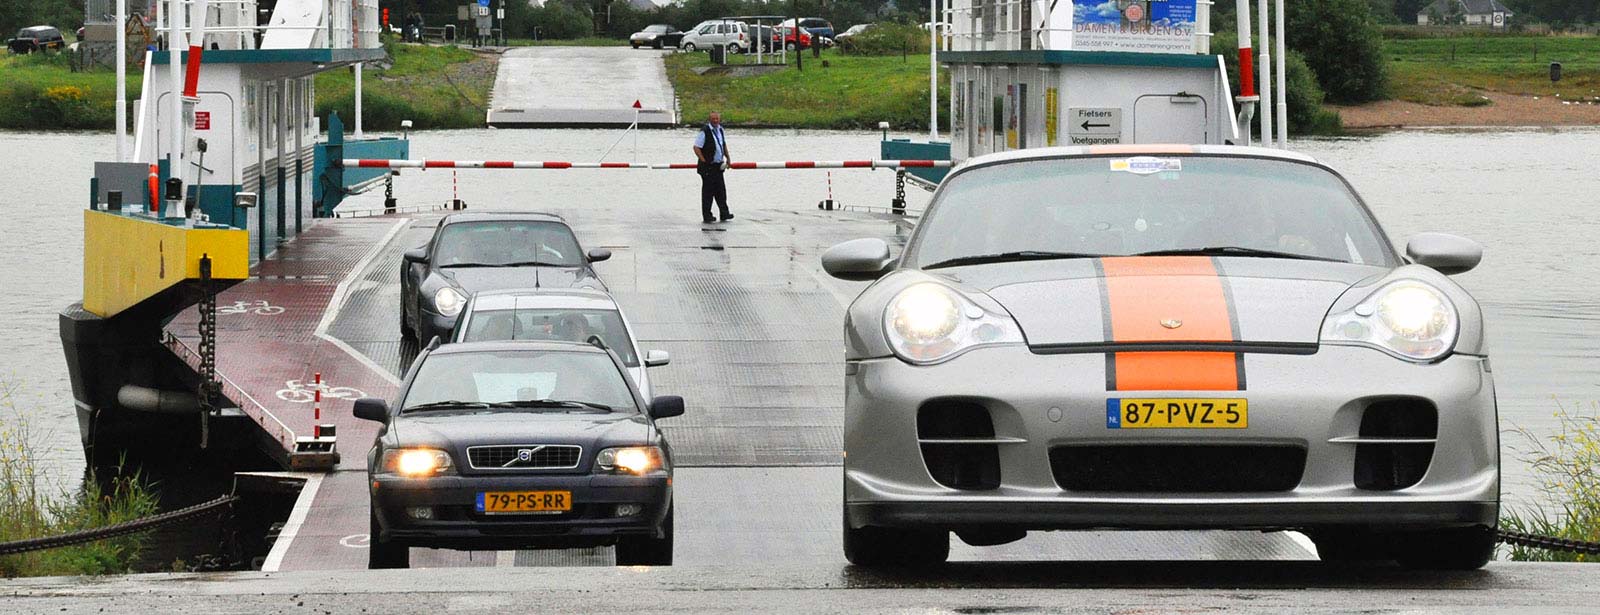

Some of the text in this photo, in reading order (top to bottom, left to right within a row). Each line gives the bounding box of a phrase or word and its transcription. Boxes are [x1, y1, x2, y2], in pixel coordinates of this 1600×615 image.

[1075, 23, 1116, 34] DAMEN
[1119, 25, 1127, 34] &
[1130, 25, 1171, 36] GROEN
[1078, 109, 1112, 117] Fietsers
[1071, 136, 1120, 145] Voetgangers
[1125, 402, 1240, 424] 87-PVZ-5
[1108, 416, 1118, 424] NL
[489, 493, 565, 509] 79-PS-RR
